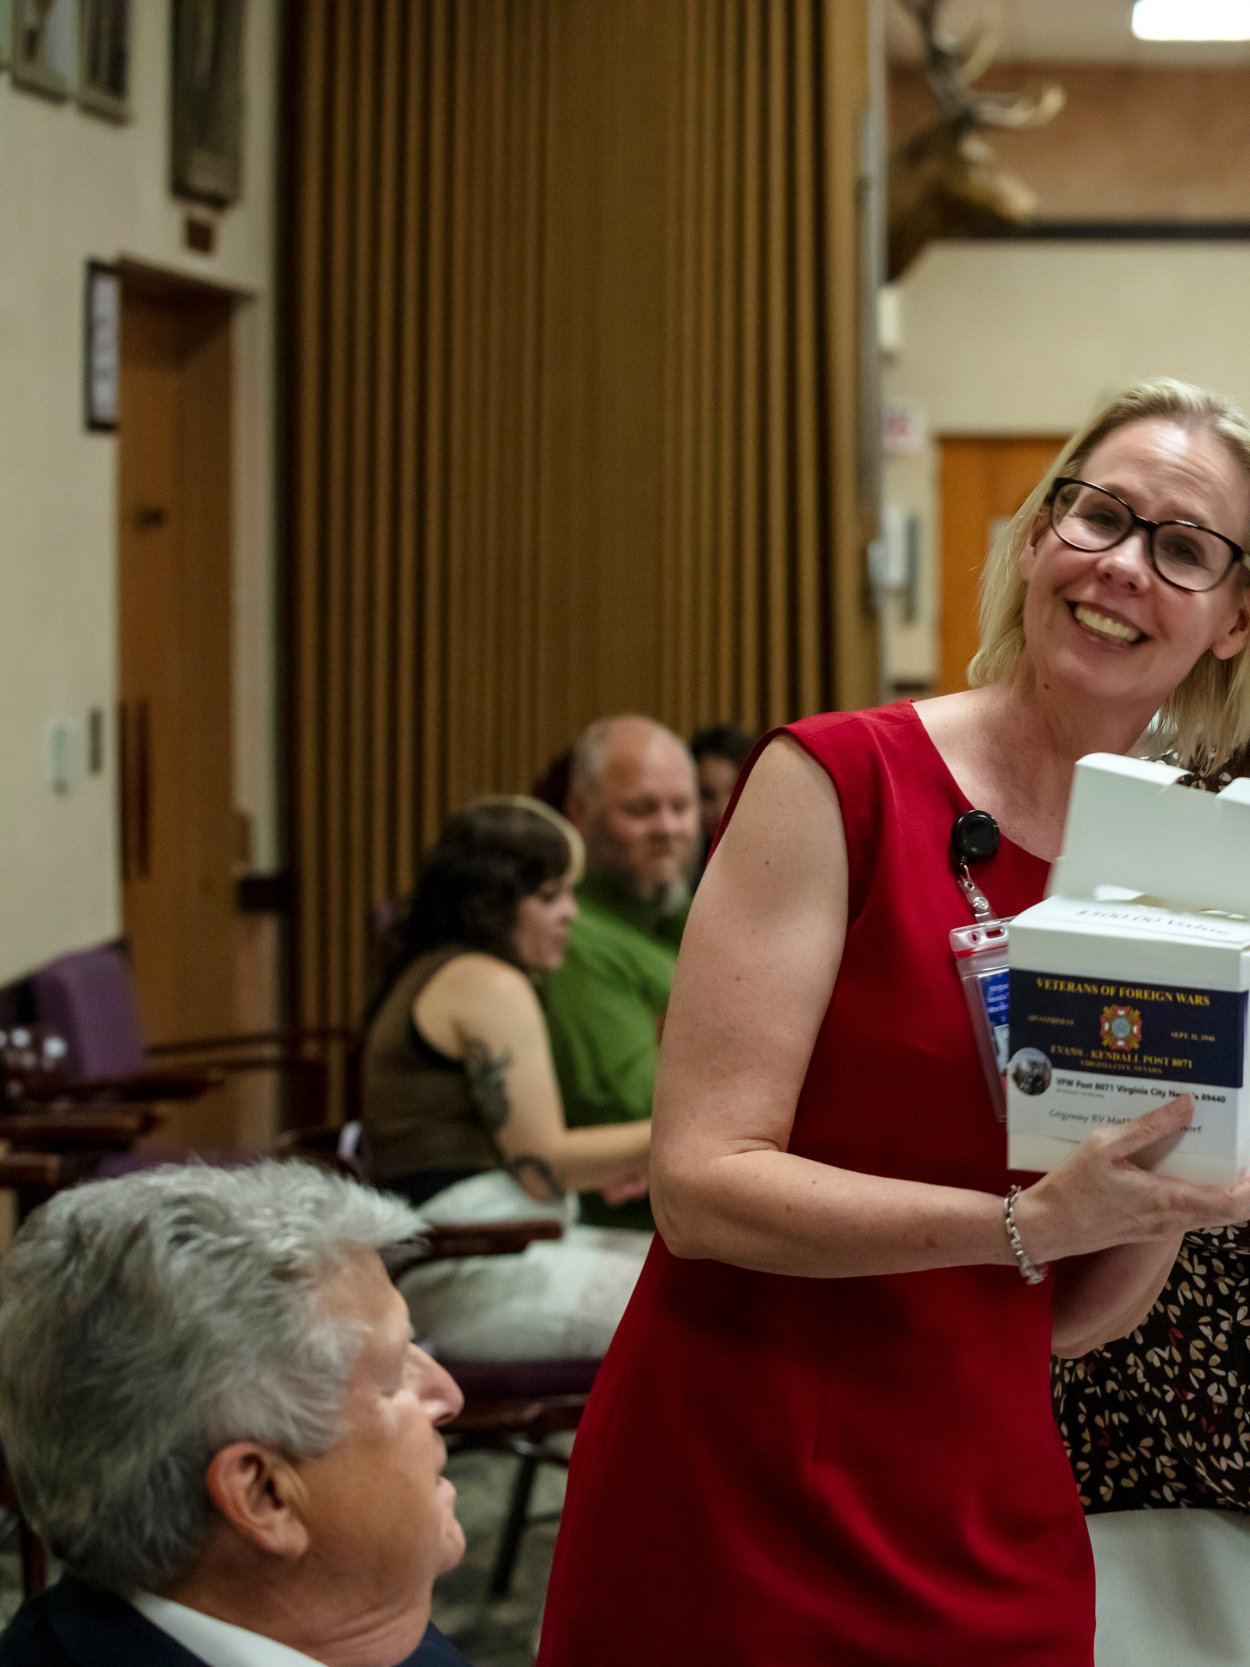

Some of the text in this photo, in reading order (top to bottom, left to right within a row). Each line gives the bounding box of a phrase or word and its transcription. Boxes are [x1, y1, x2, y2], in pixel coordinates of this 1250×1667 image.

[1036, 977, 1210, 1006] VETERANS OF FOREIGN WARS
[1143, 1055, 1169, 1066] POST
[1076, 1080, 1093, 1089] Post
[1095, 1082, 1114, 1092] 8071
[1116, 1084, 1148, 1096] Virginia
[1150, 1088, 1167, 1099] City
